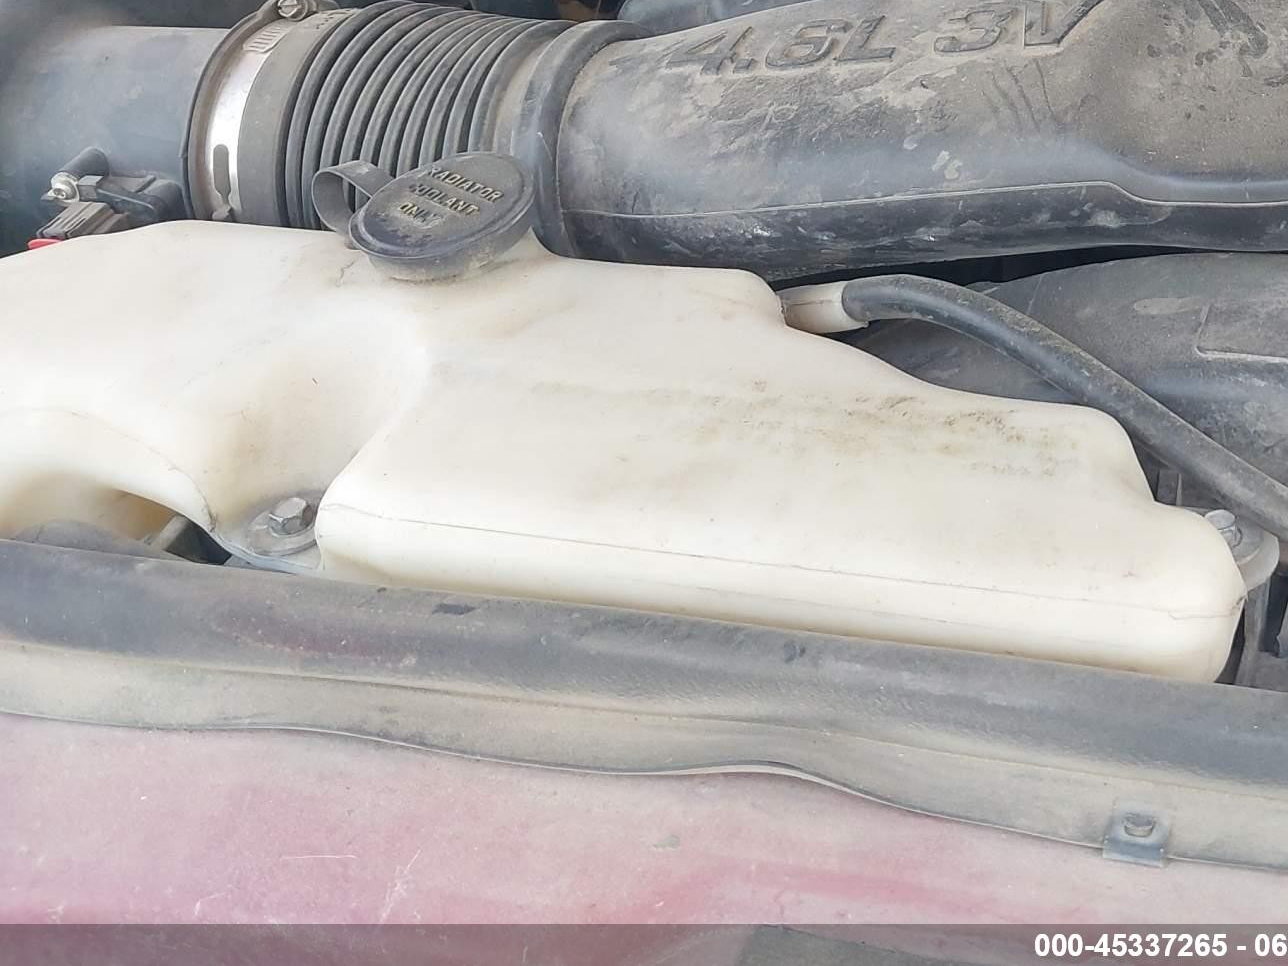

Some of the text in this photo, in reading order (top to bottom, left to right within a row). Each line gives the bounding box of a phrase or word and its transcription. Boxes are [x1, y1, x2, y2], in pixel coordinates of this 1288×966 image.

[664, 14, 898, 76] 4.6L
[409, 183, 481, 217] COOLANT
[422, 166, 503, 204] RADIATOR
[398, 201, 446, 229] ONLY
